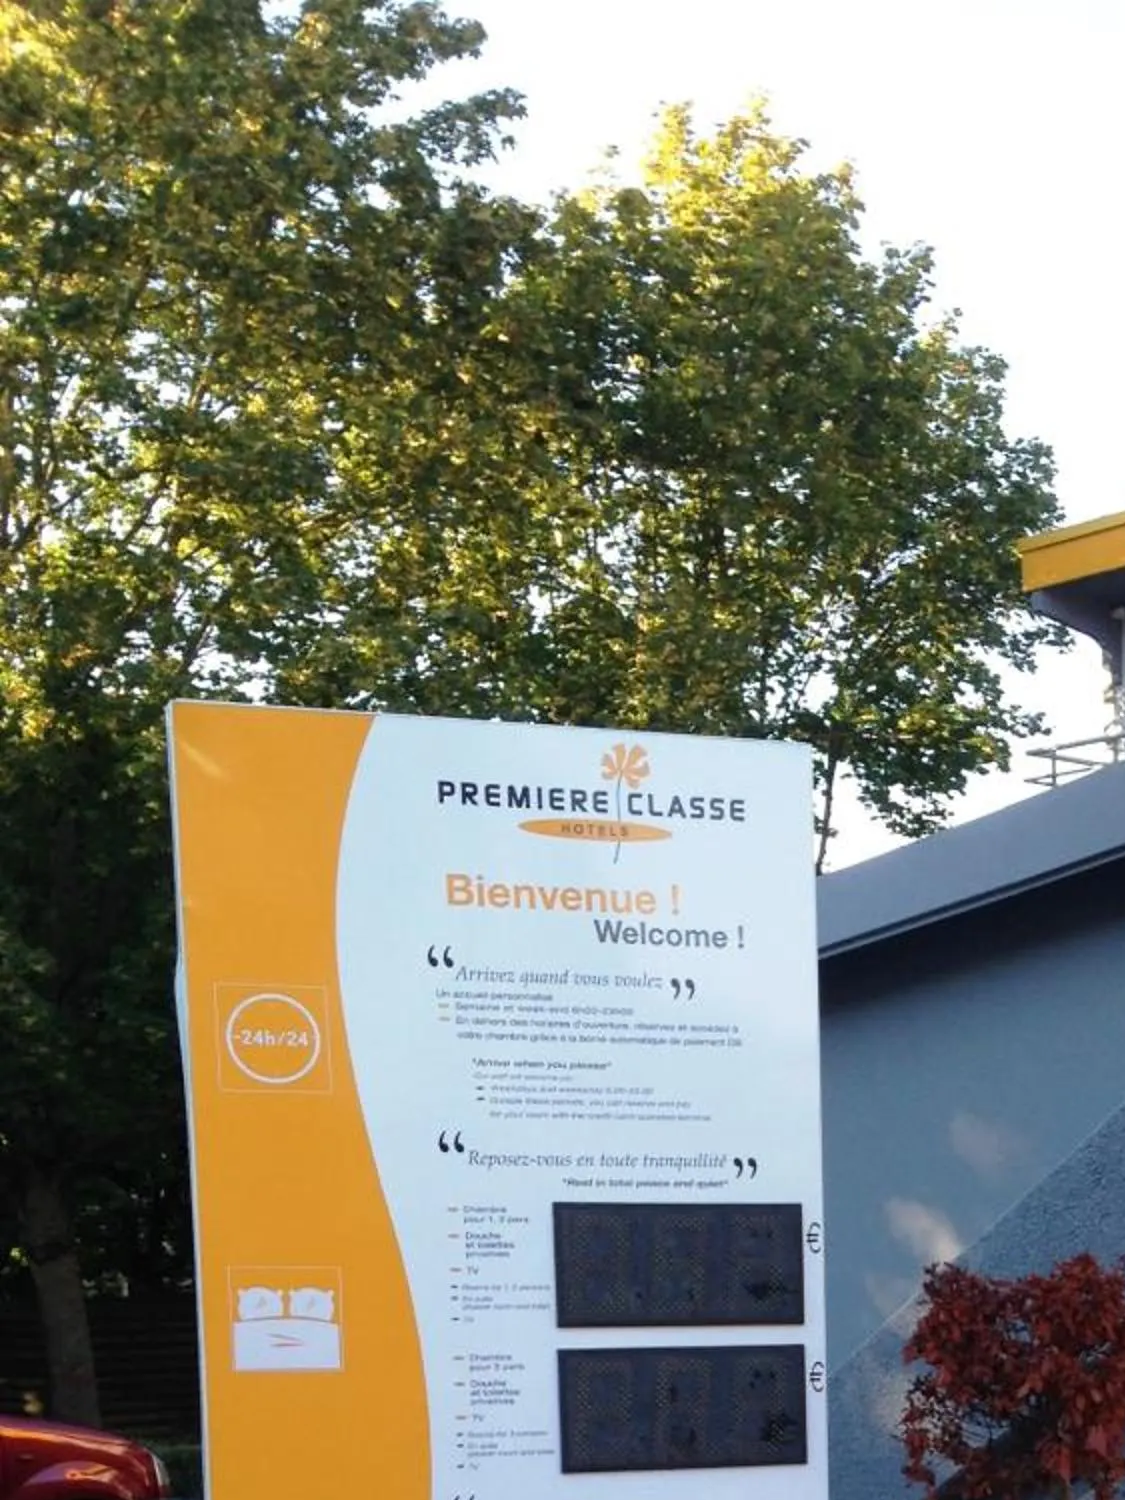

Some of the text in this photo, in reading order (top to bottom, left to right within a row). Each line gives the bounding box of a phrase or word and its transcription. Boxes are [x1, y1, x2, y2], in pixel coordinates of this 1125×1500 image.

[438, 780, 746, 822] PREMIERE CLASSE
[561, 823, 630, 837] HOTELS
[446, 873, 657, 915] Bienvenue
[593, 919, 728, 948] Welcome
[455, 966, 515, 984] Arrivez
[519, 969, 569, 988] quand
[573, 973, 609, 987] vous
[240, 1029, 308, 1048] 24h/24
[468, 1150, 572, 1175] Reposez-vous
[577, 1155, 595, 1168] en
[600, 1152, 638, 1168] toute
